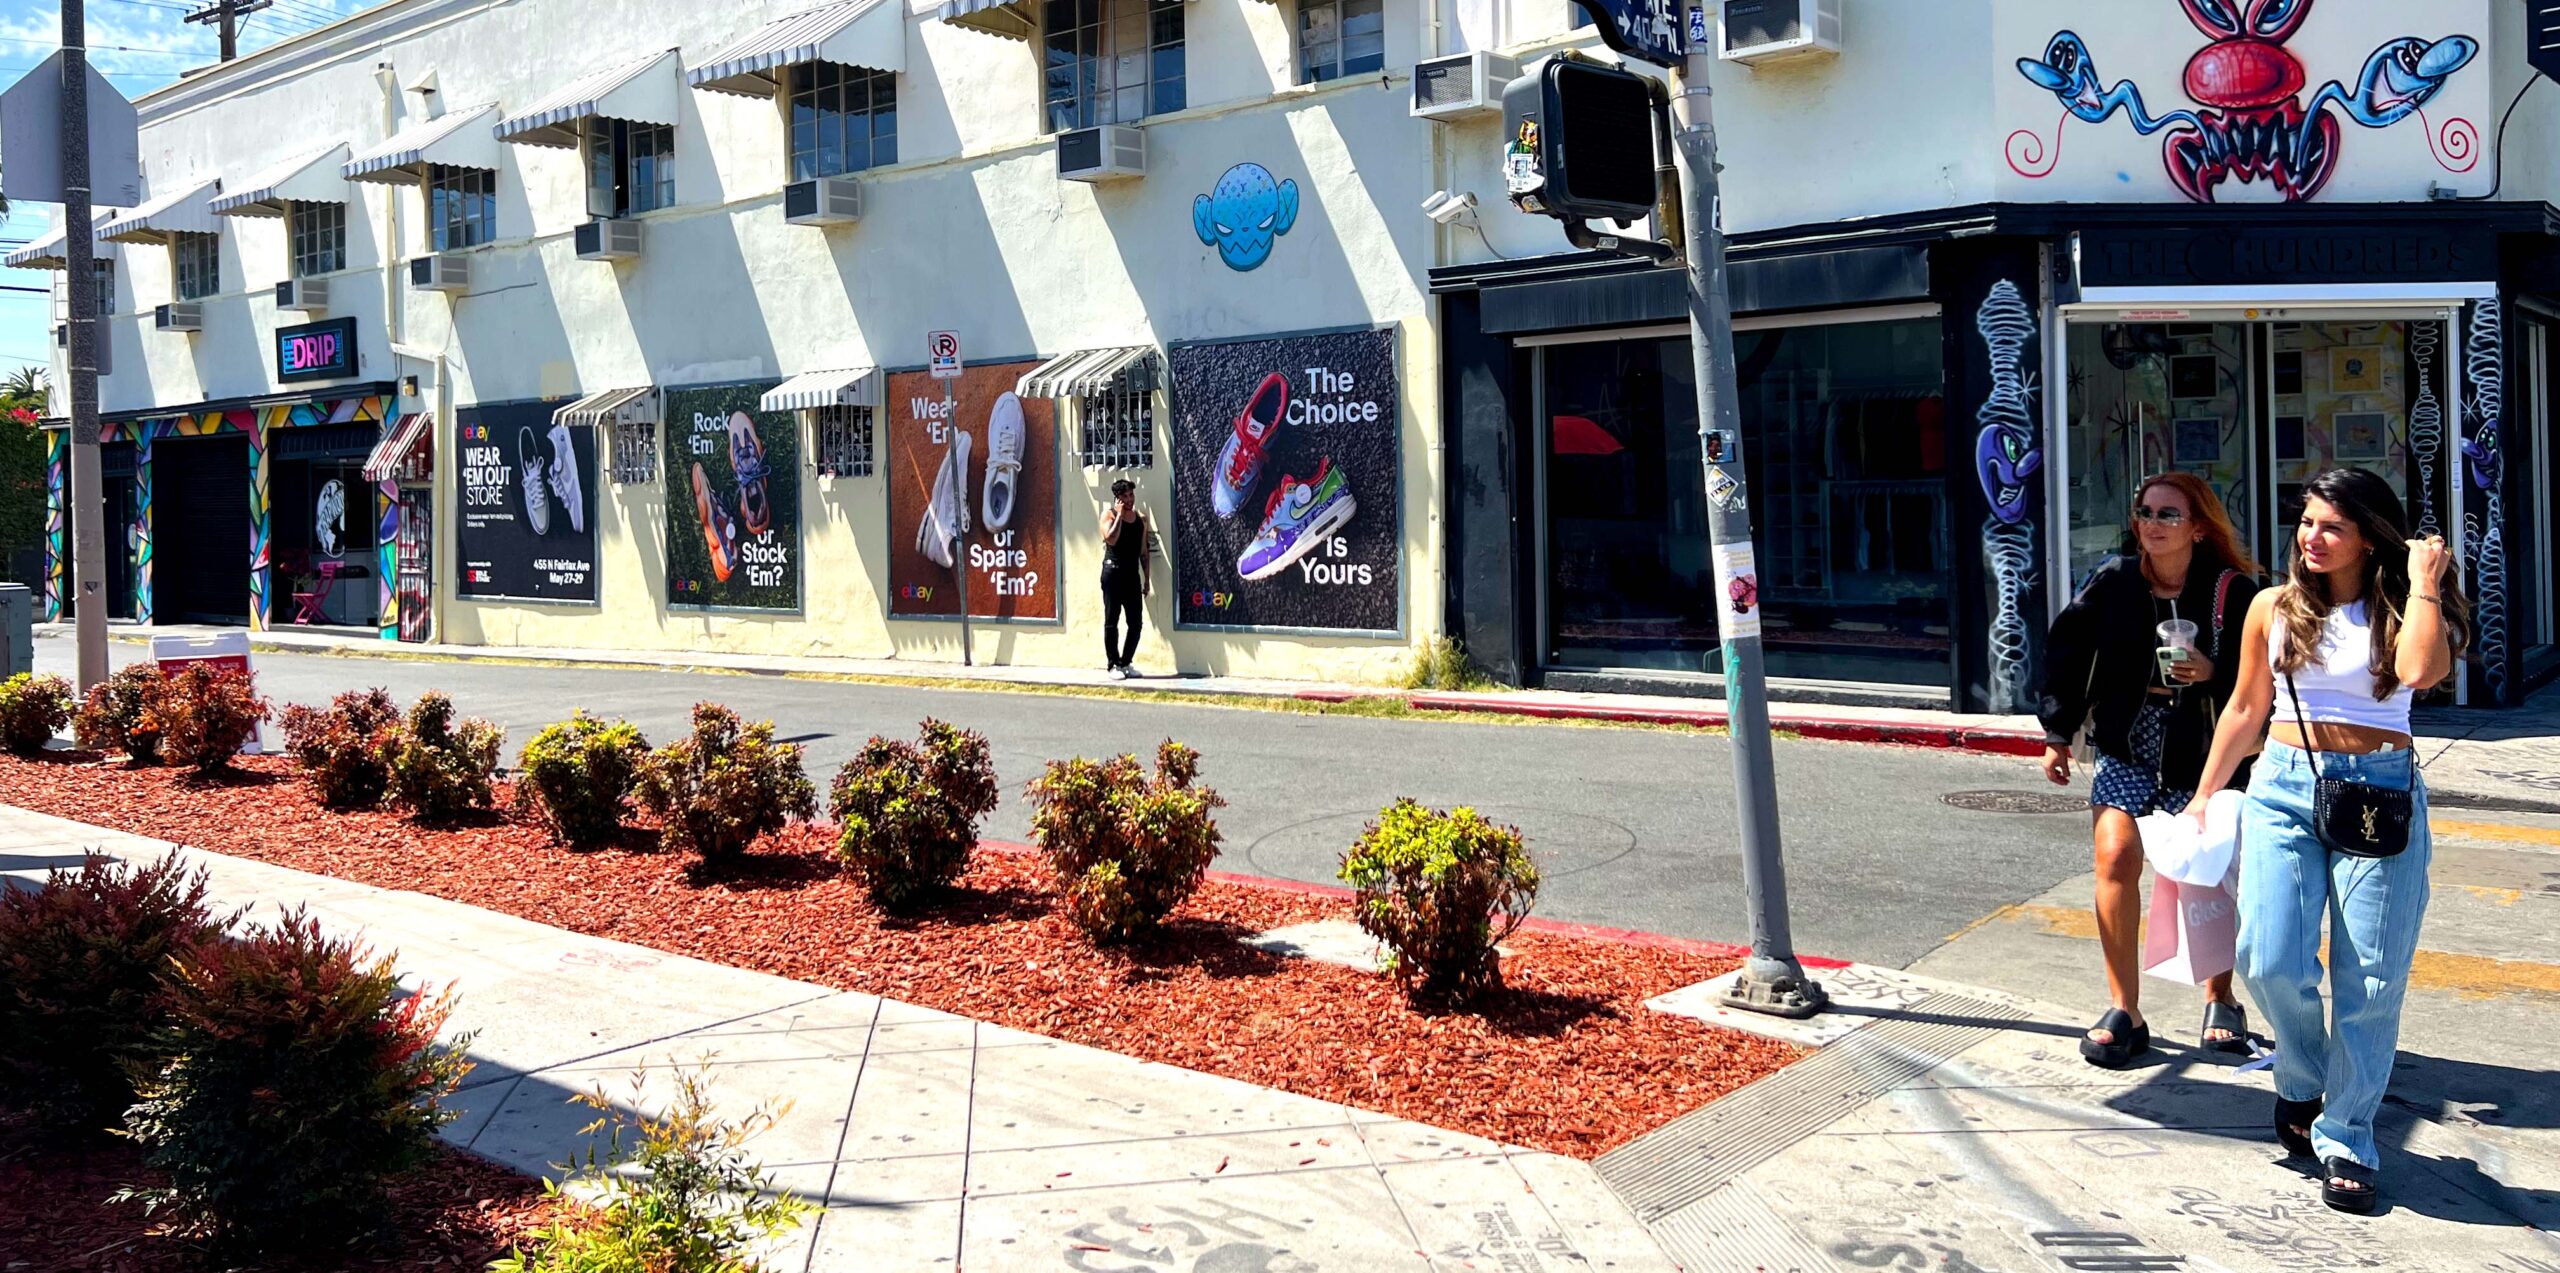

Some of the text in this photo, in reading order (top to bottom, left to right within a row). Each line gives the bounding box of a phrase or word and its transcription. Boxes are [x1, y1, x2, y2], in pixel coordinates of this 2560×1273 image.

[2229, 235, 2472, 275] HUNDREDS
[293, 334, 336, 369] DRIP
[1305, 367, 1354, 394] The
[911, 396, 958, 419] Wear
[1286, 396, 1379, 425] Choice
[694, 411, 730, 432] Rock
[464, 424, 490, 442] ebay
[466, 446, 501, 466] WEAR
[485, 467, 511, 485] OUT
[466, 486, 503, 505] STORE
[742, 543, 787, 564] Stock
[1326, 534, 1348, 558] Is
[533, 559, 590, 572] 455 N Fairfax Ave
[970, 544, 1027, 571] Spare
[549, 572, 584, 586] May 27-29
[1299, 557, 1372, 585] Yours
[677, 578, 701, 594] ebay
[902, 583, 933, 602] ebay
[1192, 590, 1233, 610] ebay
